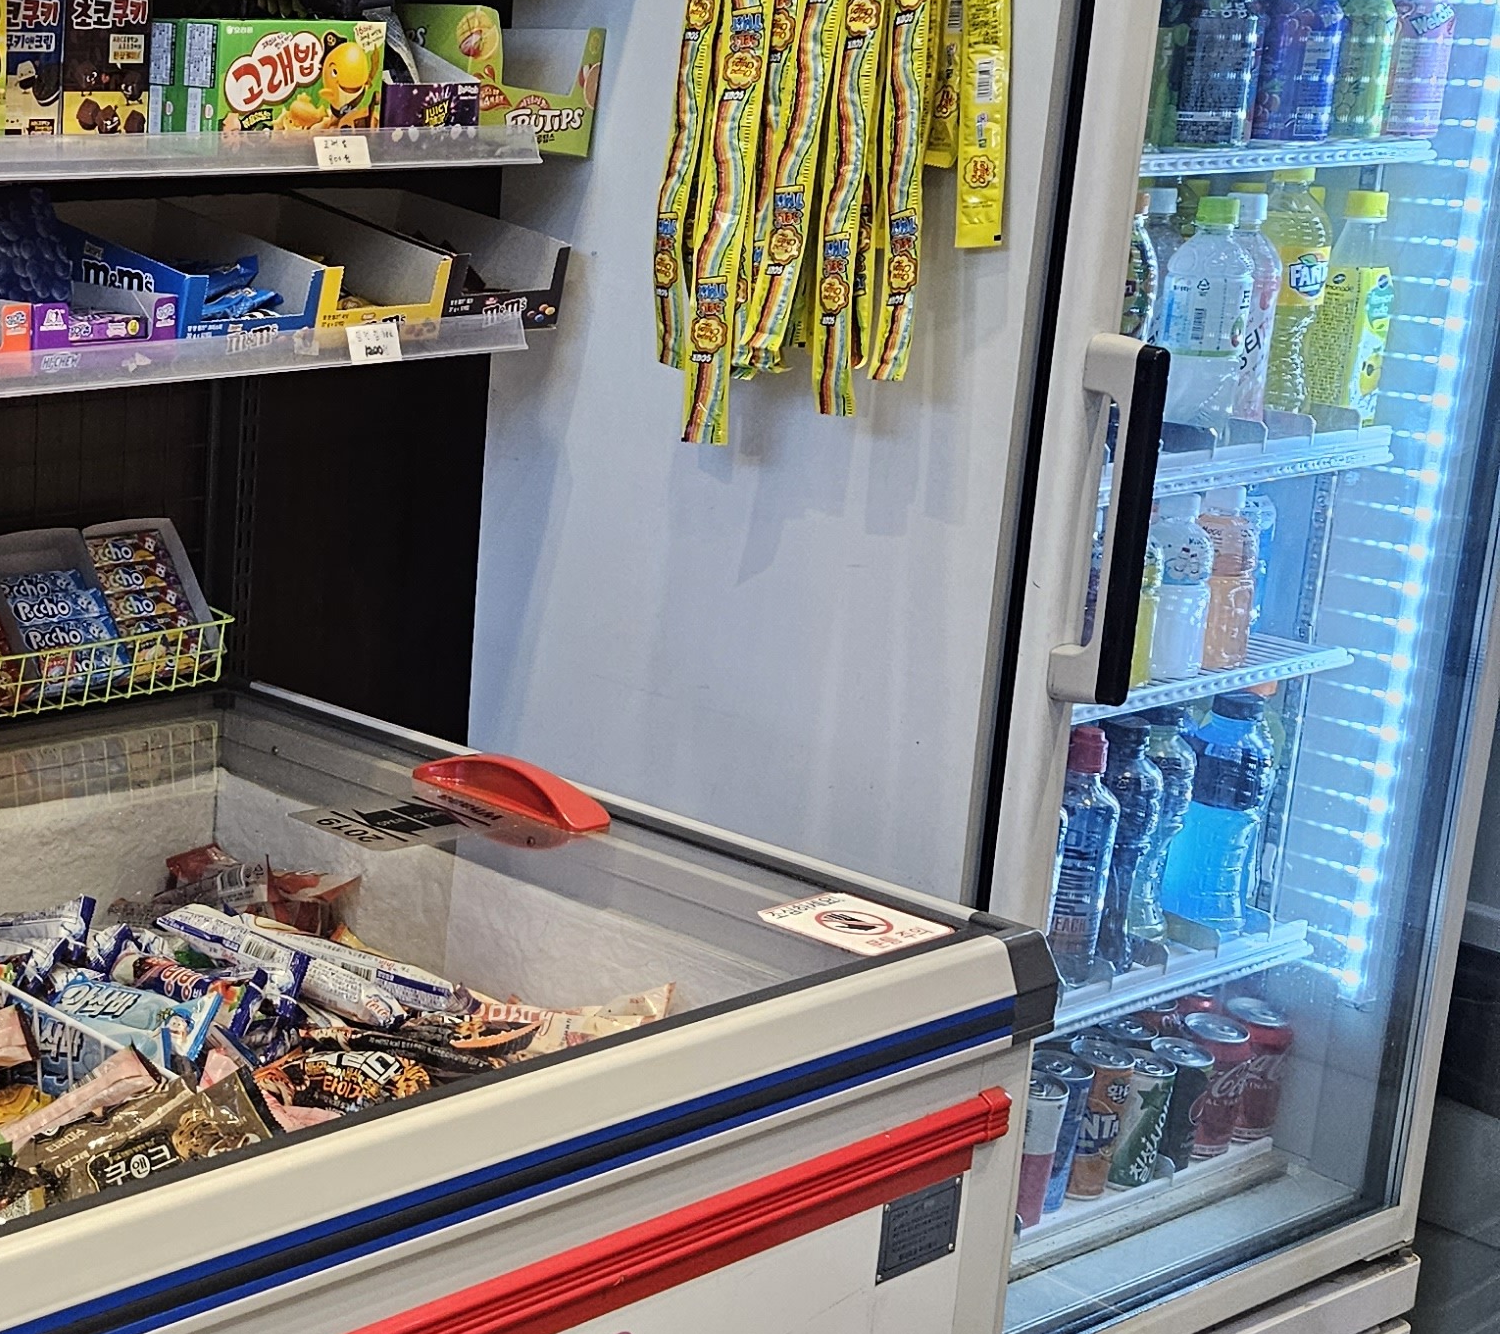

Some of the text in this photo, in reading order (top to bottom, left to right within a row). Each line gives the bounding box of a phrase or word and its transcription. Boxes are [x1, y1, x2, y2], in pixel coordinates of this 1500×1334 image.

[233, 39, 320, 105] 고래밥
[423, 102, 449, 123] JUICY
[16, 597, 71, 623] Puccho
[30, 625, 83, 649] Puccho
[316, 818, 385, 843] 2019
